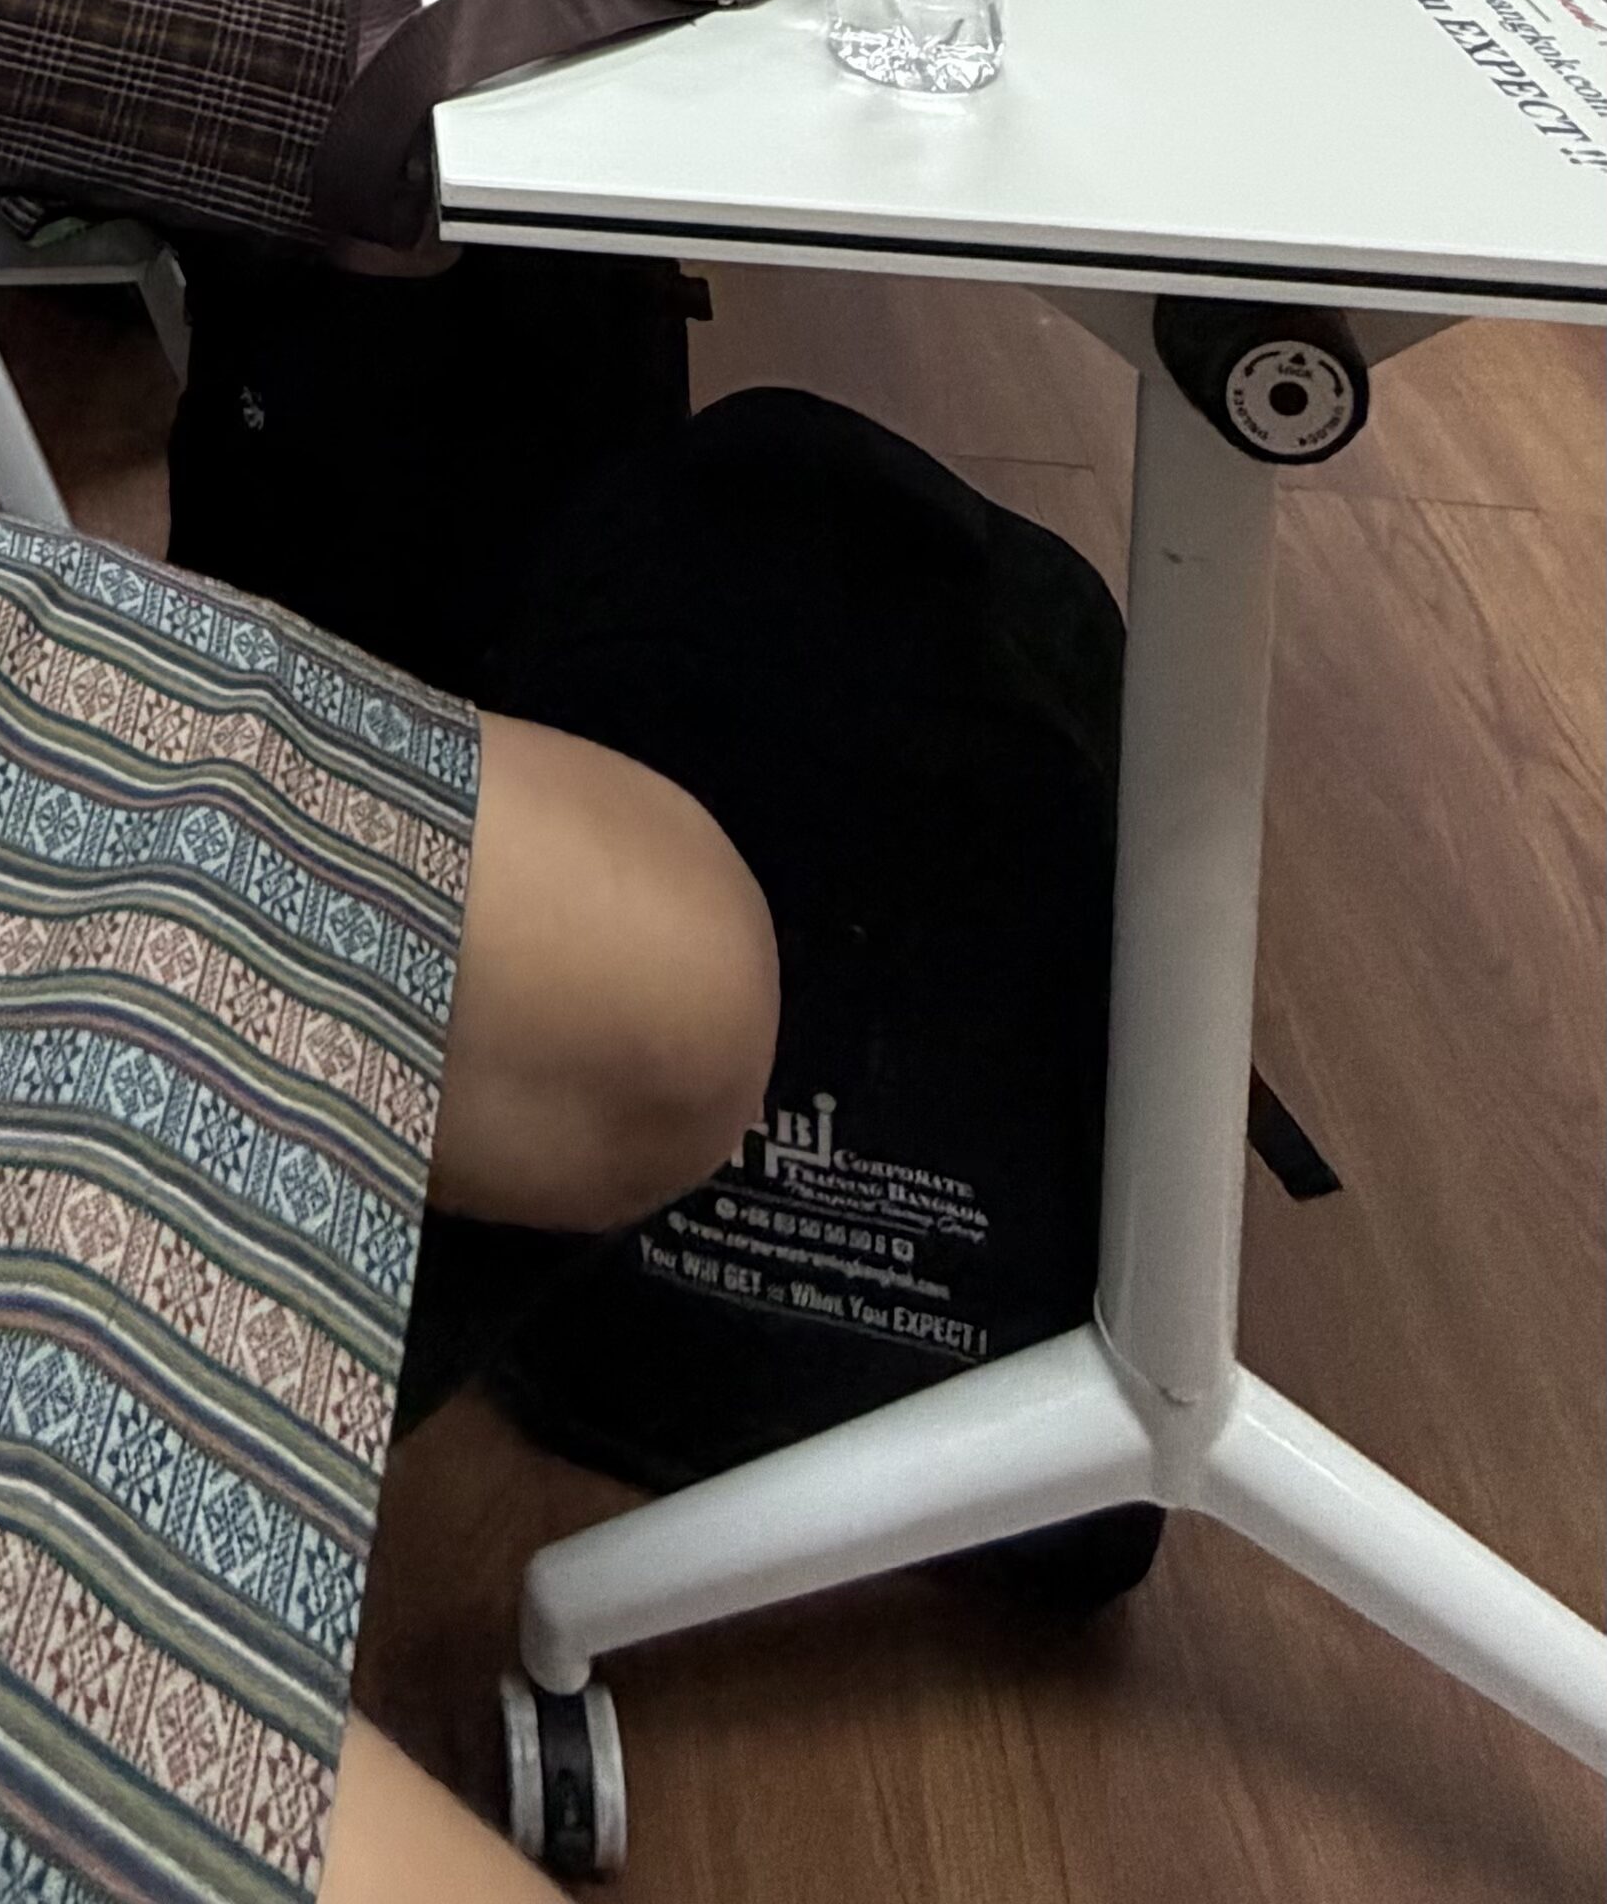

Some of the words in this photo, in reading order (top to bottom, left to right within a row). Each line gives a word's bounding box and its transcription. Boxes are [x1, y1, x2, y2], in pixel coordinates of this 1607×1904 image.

[1434, 16, 1593, 144] EXPECT
[640, 1234, 679, 1270] You
[723, 1262, 762, 1296] GET
[849, 1295, 889, 1328] You
[892, 1306, 973, 1351] EXPECT
